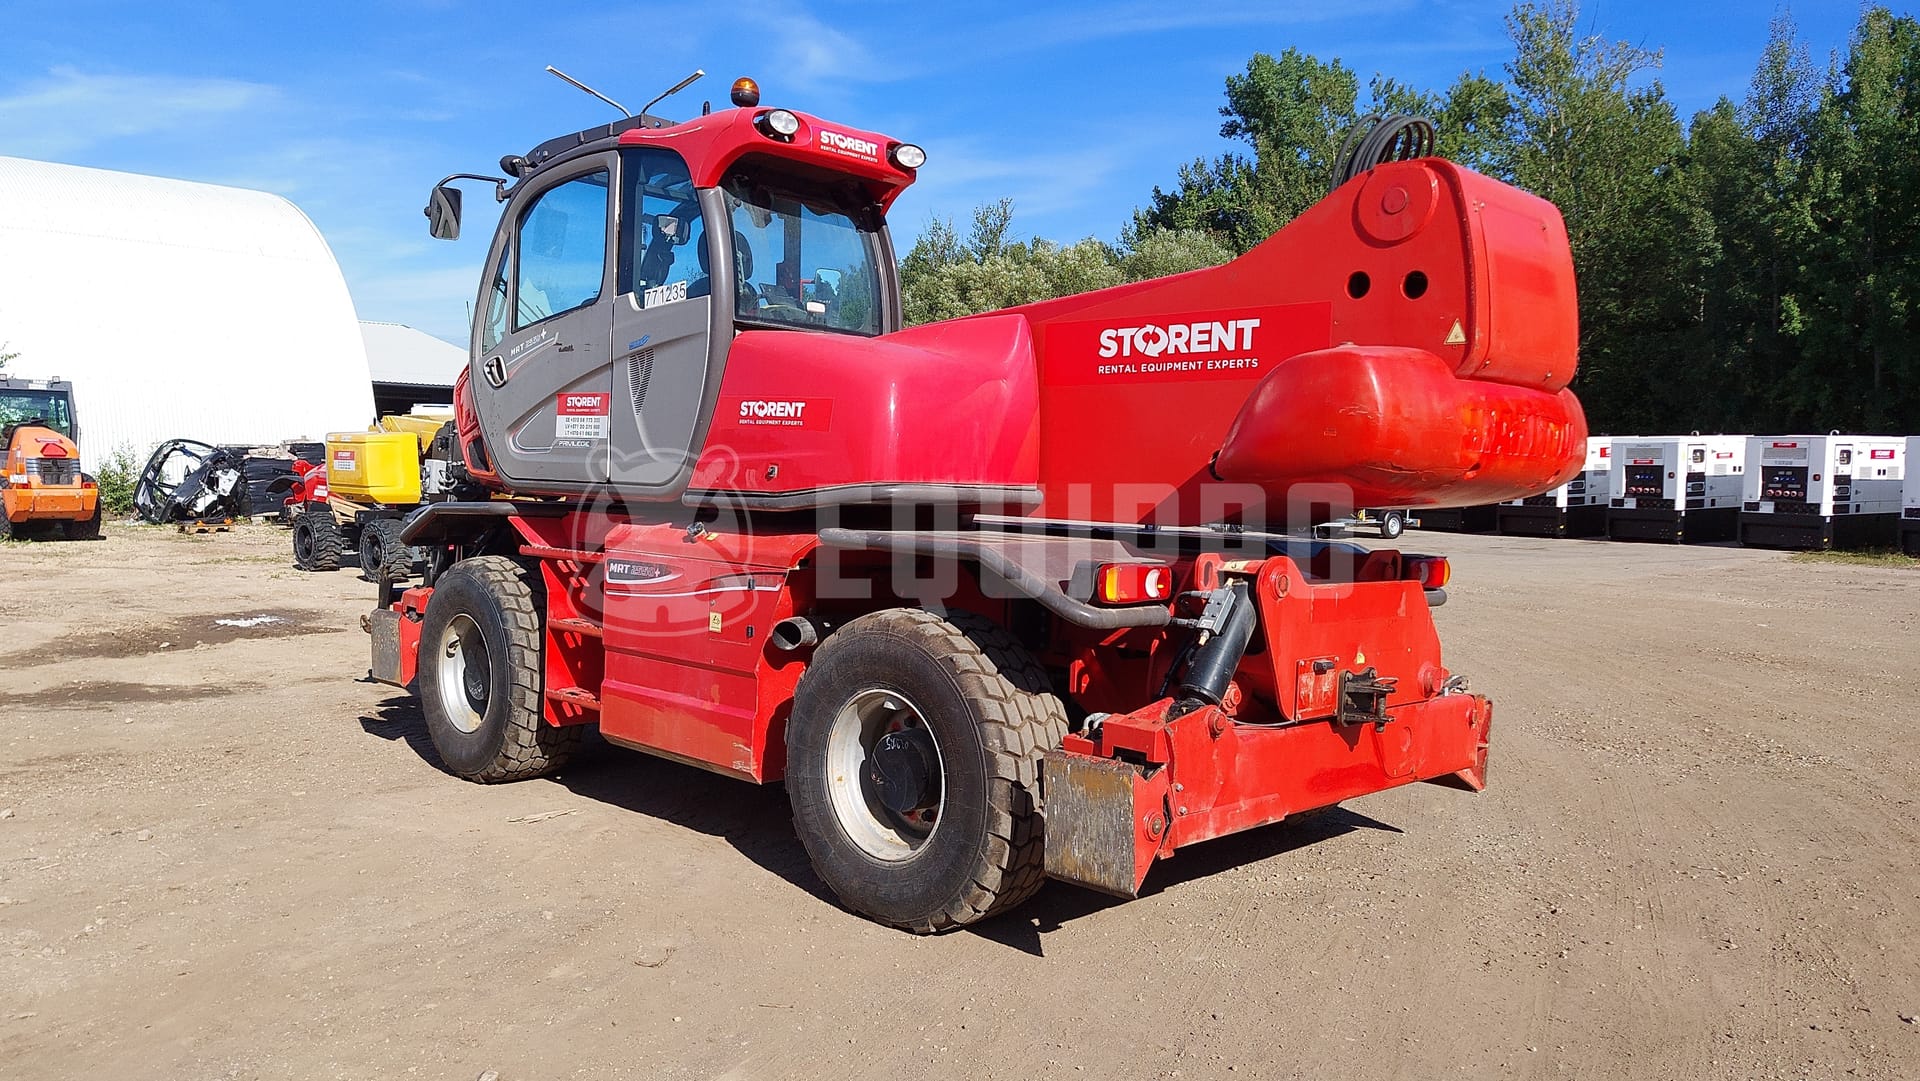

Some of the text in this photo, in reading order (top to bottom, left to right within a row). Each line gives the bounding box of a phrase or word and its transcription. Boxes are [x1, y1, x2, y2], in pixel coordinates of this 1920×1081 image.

[820, 130, 878, 156] STORENT
[645, 283, 686, 307] 771235
[1098, 318, 1261, 358] STORENT
[1098, 358, 1259, 374] RENTAL EQUIPMENT EXPERTS
[566, 396, 601, 407] STORENT
[739, 400, 806, 418] STORENT
[609, 562, 631, 575] MRT
